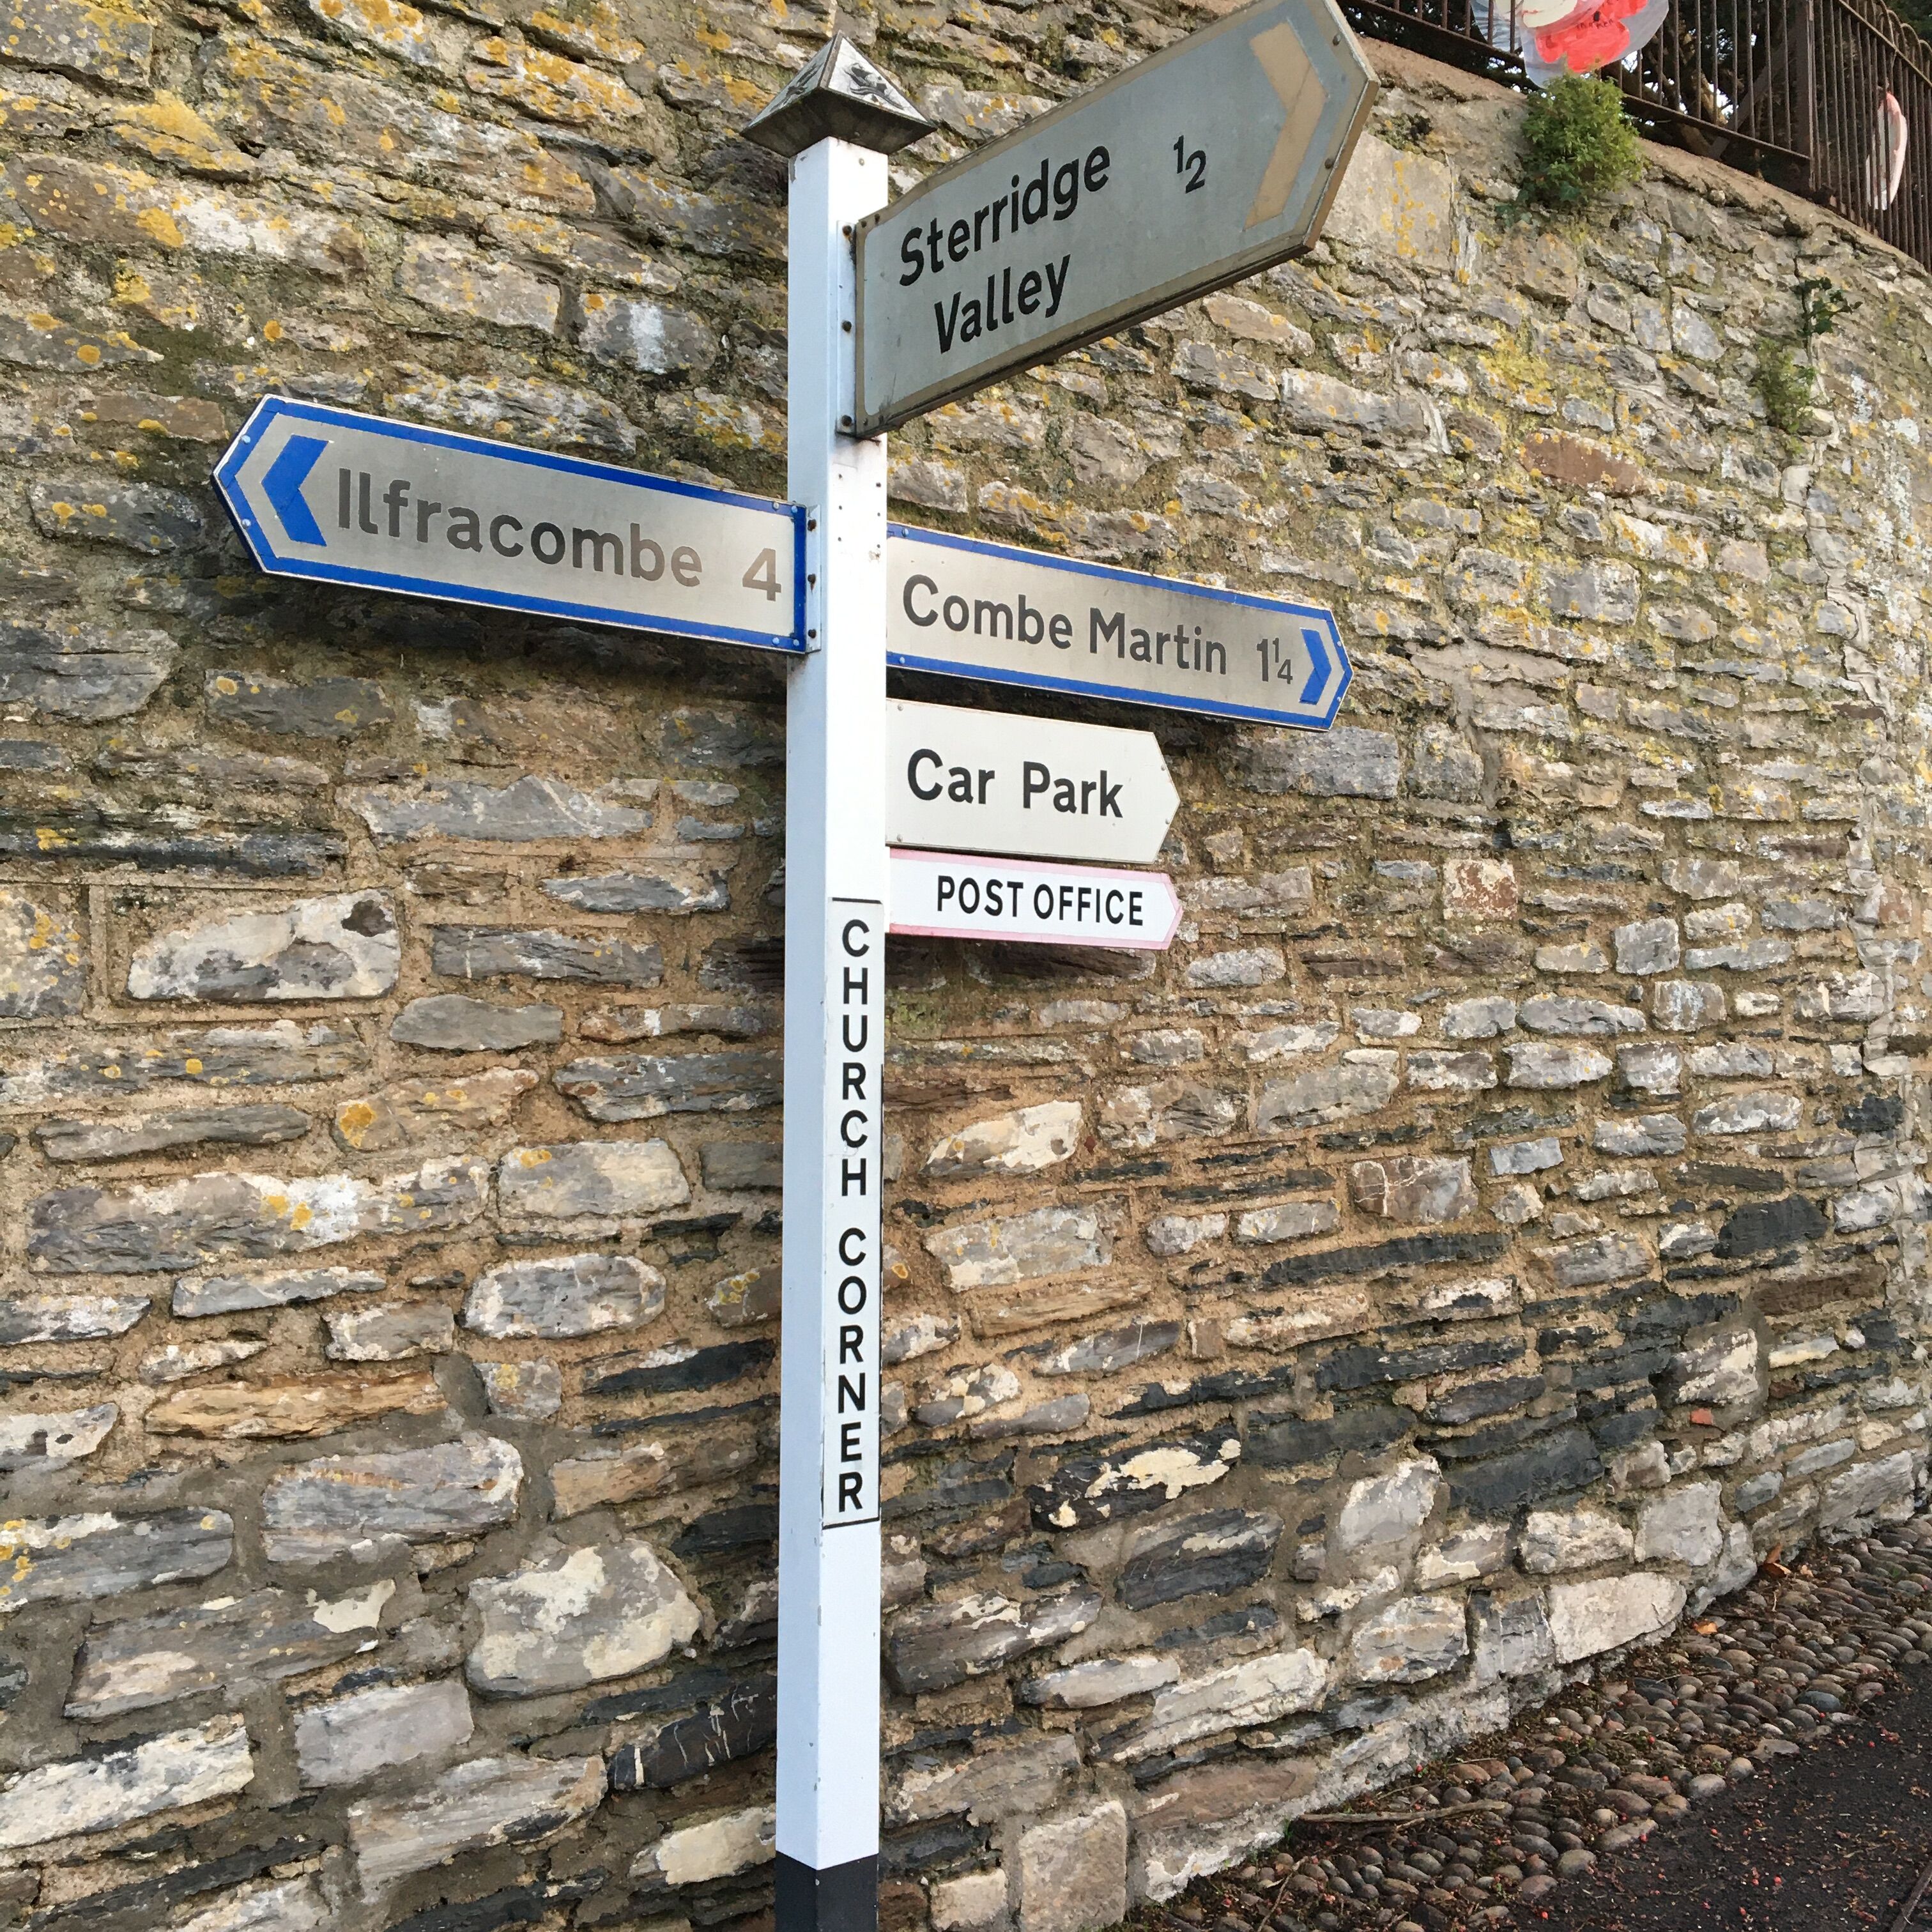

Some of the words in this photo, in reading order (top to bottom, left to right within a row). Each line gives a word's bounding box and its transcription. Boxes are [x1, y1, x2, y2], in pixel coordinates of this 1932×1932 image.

[899, 145, 1111, 288] Sterridge
[933, 254, 1071, 355] Valley
[337, 467, 703, 587] Ilfracombe
[742, 548, 781, 602] 4
[902, 574, 1073, 650] Combe
[1089, 606, 1227, 675] Martin
[907, 748, 995, 805] Car
[1022, 760, 1124, 818] Park
[937, 875, 1023, 917] POST
[1033, 884, 1144, 926] OFFICE
[840, 919, 870, 1197] CHURCH
[838, 1227, 868, 1513] CORNER
